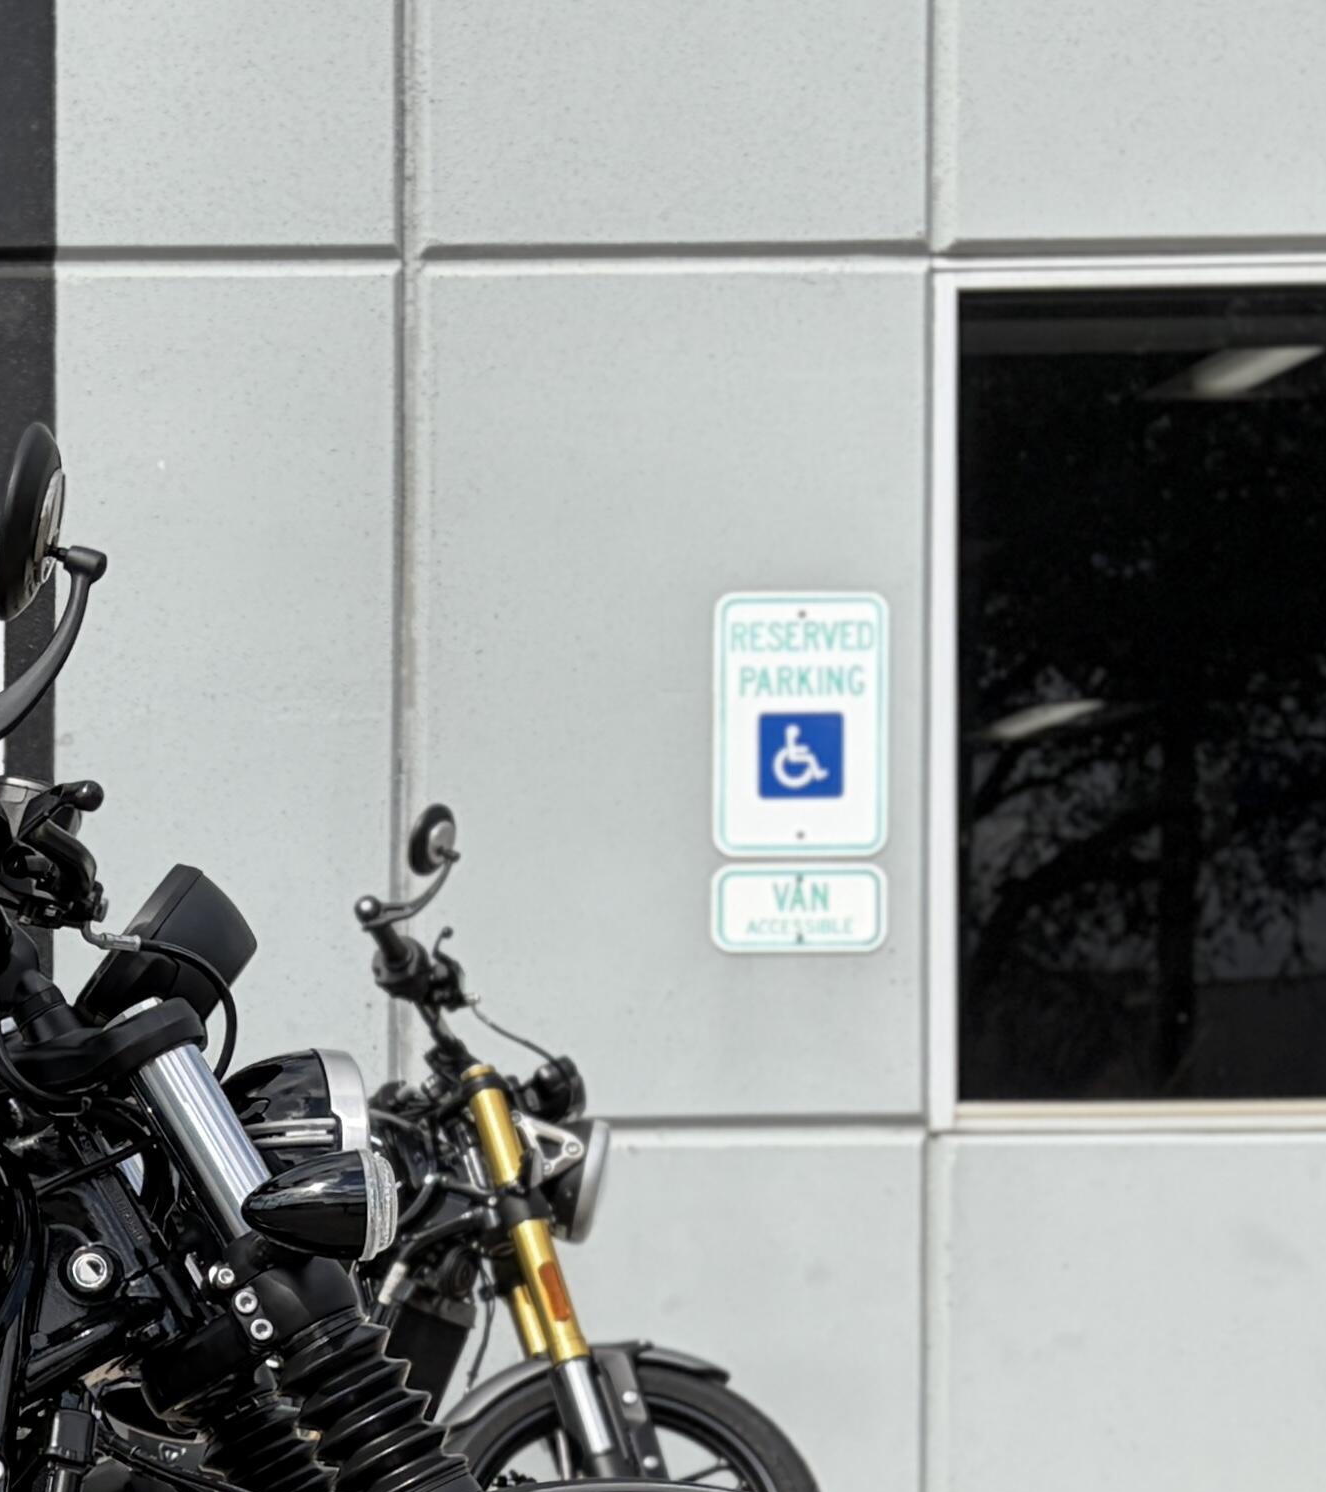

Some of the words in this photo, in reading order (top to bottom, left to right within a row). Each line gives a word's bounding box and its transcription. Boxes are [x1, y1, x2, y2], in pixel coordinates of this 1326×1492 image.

[730, 620, 874, 652] RESERVED
[739, 666, 865, 697] PARKING
[773, 881, 829, 912] VAN
[746, 918, 853, 935] ACCESSIBLE
